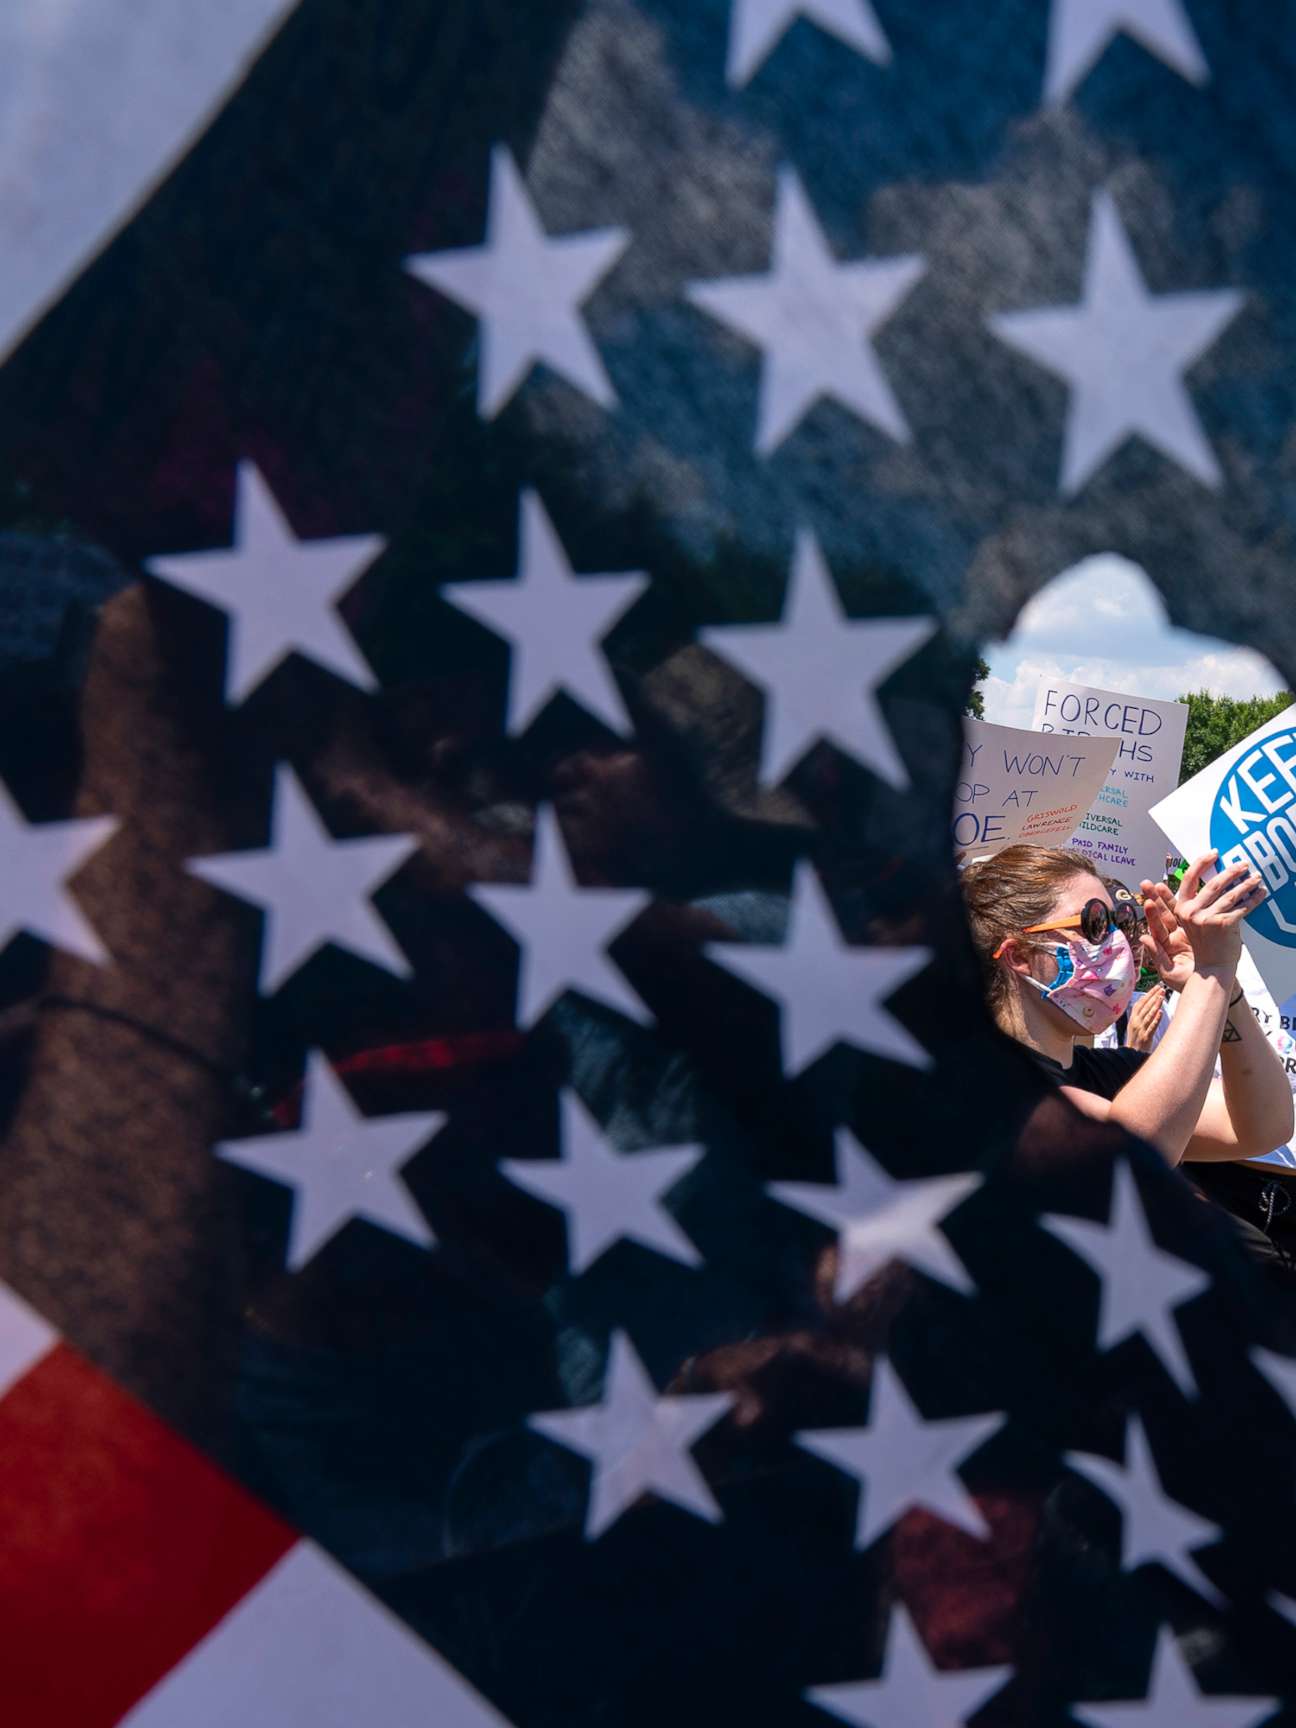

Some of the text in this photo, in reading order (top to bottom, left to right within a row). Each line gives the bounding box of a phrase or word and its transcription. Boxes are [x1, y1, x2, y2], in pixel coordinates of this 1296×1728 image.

[1045, 690, 1162, 736] FORCED
[1003, 750, 1086, 776] WON'T
[1124, 770, 1155, 783] WITH
[1002, 790, 1039, 808] AT
[1101, 785, 1129, 799] RSAL
[1072, 838, 1129, 854] PAID FAMILY
[1111, 855, 1136, 866] LEAVE
